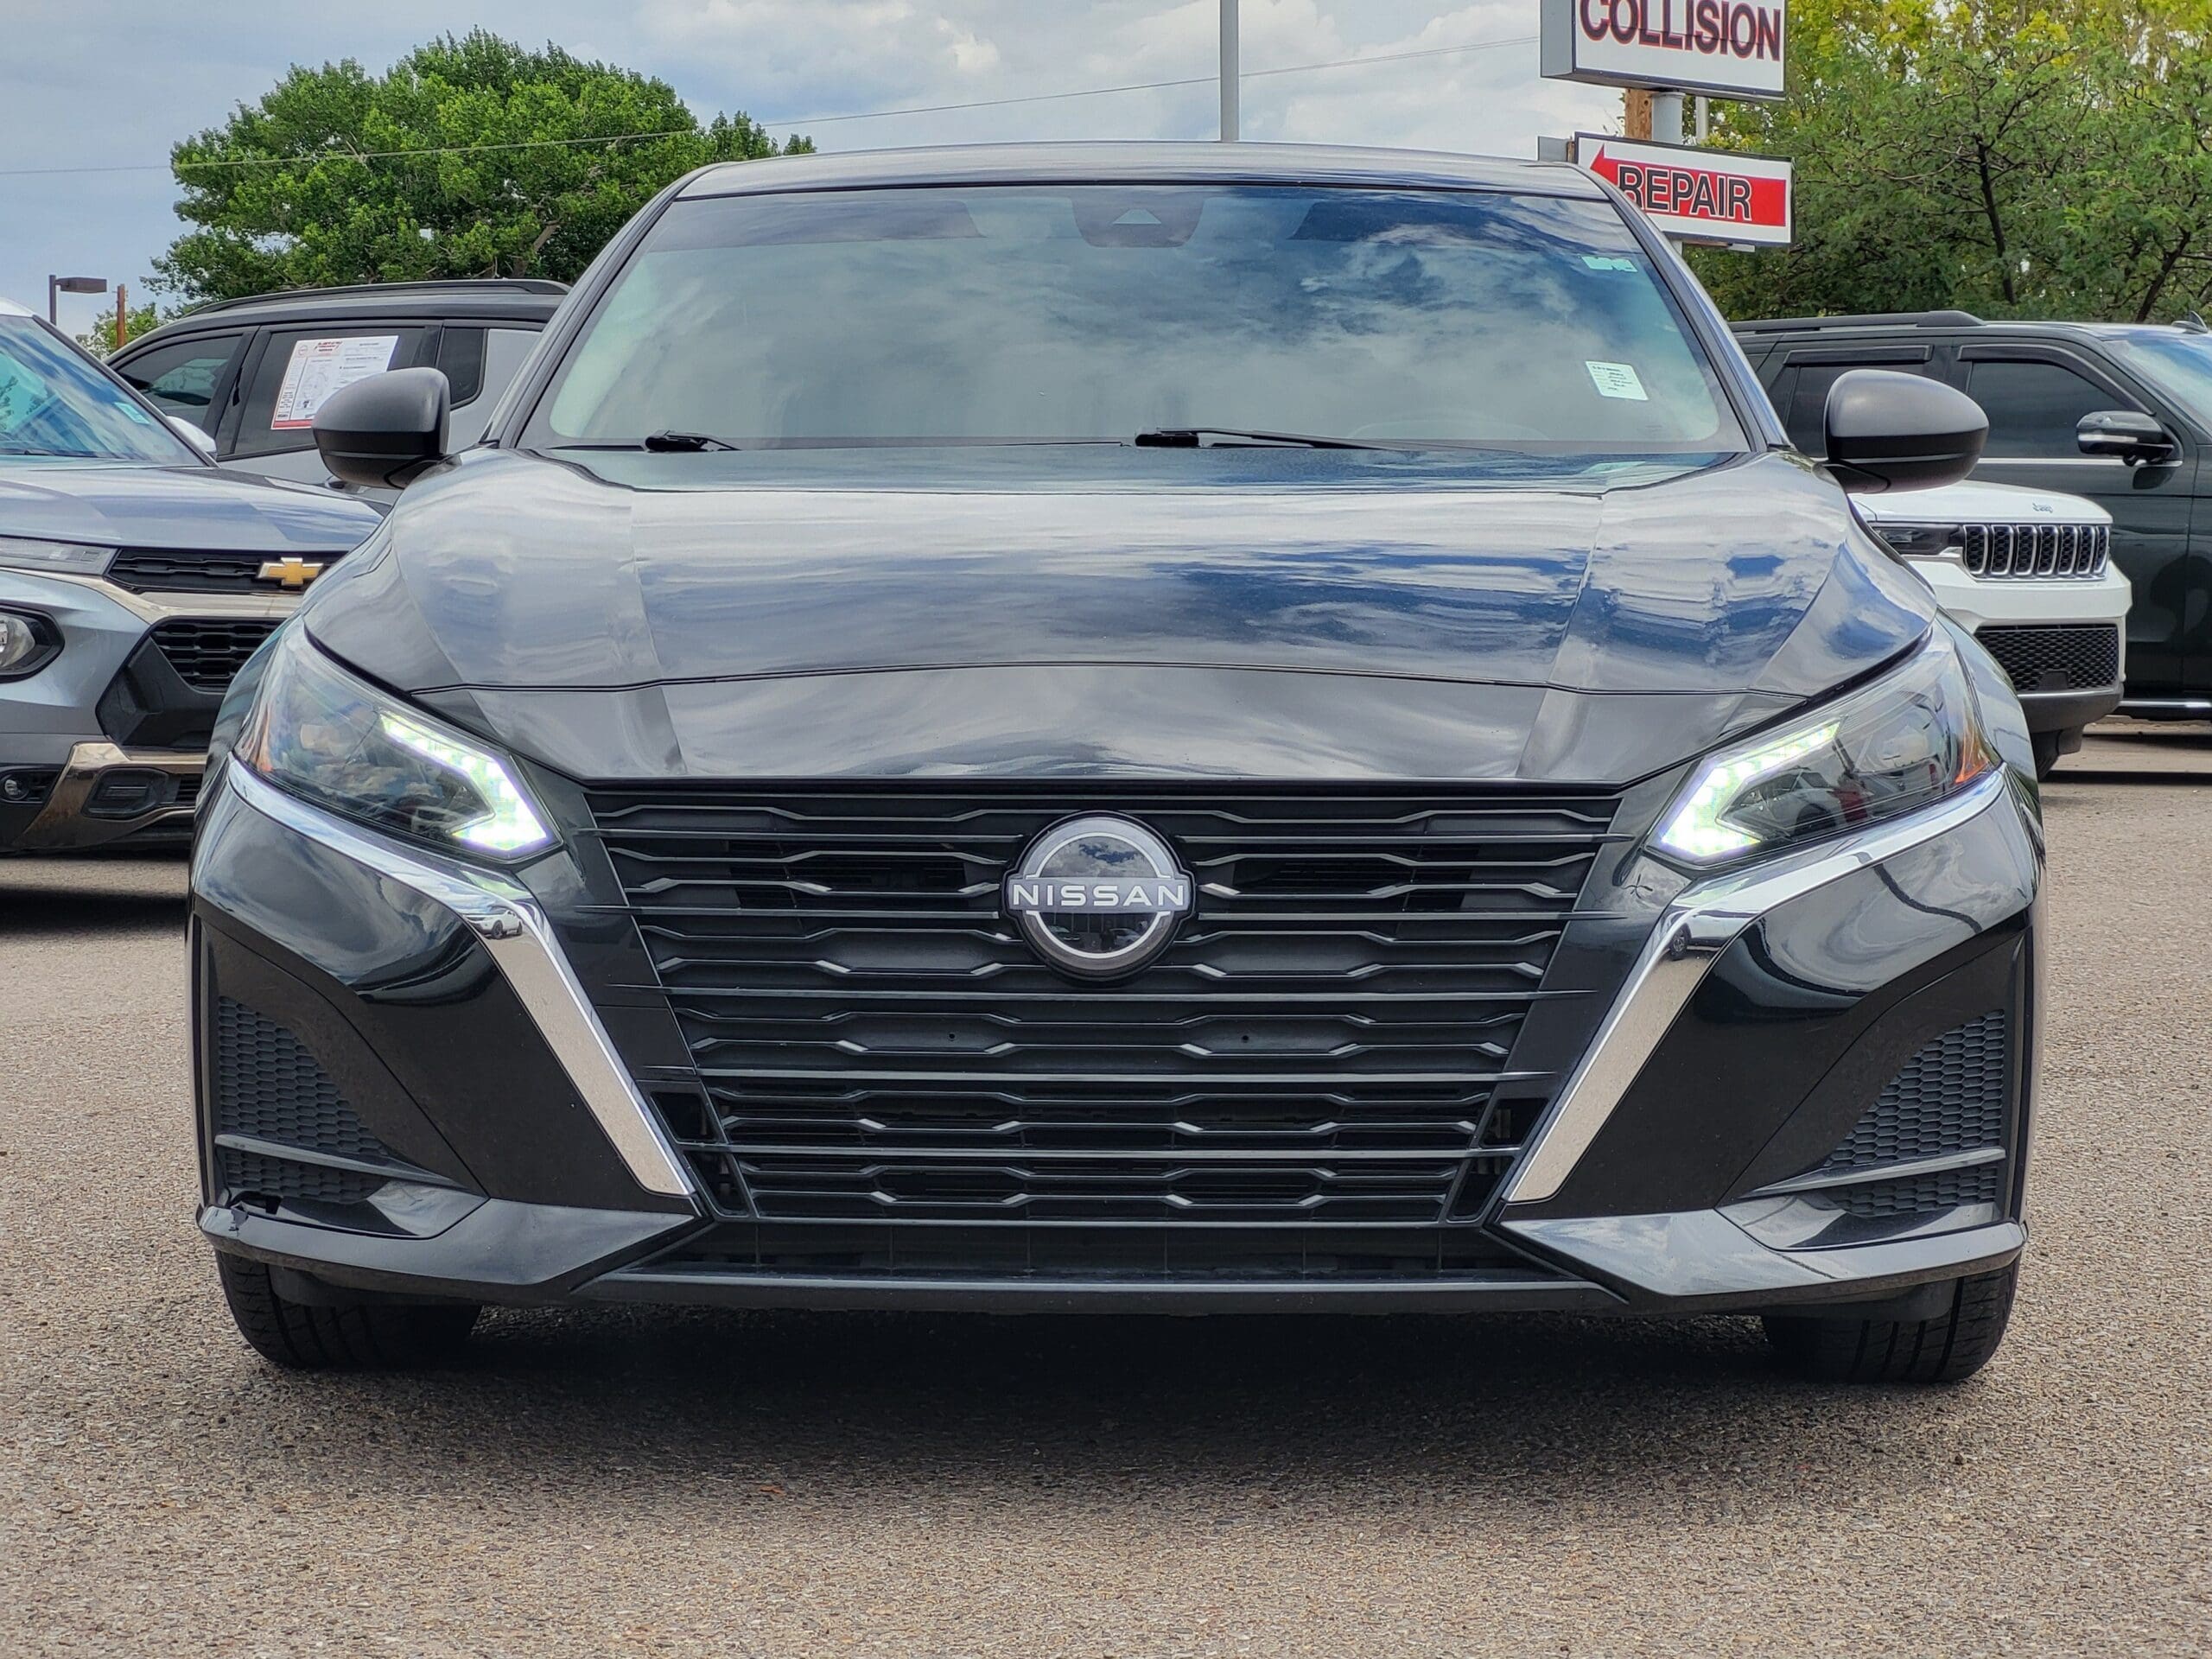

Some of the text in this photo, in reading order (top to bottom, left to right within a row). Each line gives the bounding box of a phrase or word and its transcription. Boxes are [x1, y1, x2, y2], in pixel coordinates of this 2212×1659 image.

[1580, 0, 1780, 60] COLLISION
[1618, 164, 1751, 220] REPAIR
[1013, 884, 1184, 906] NISSAN
